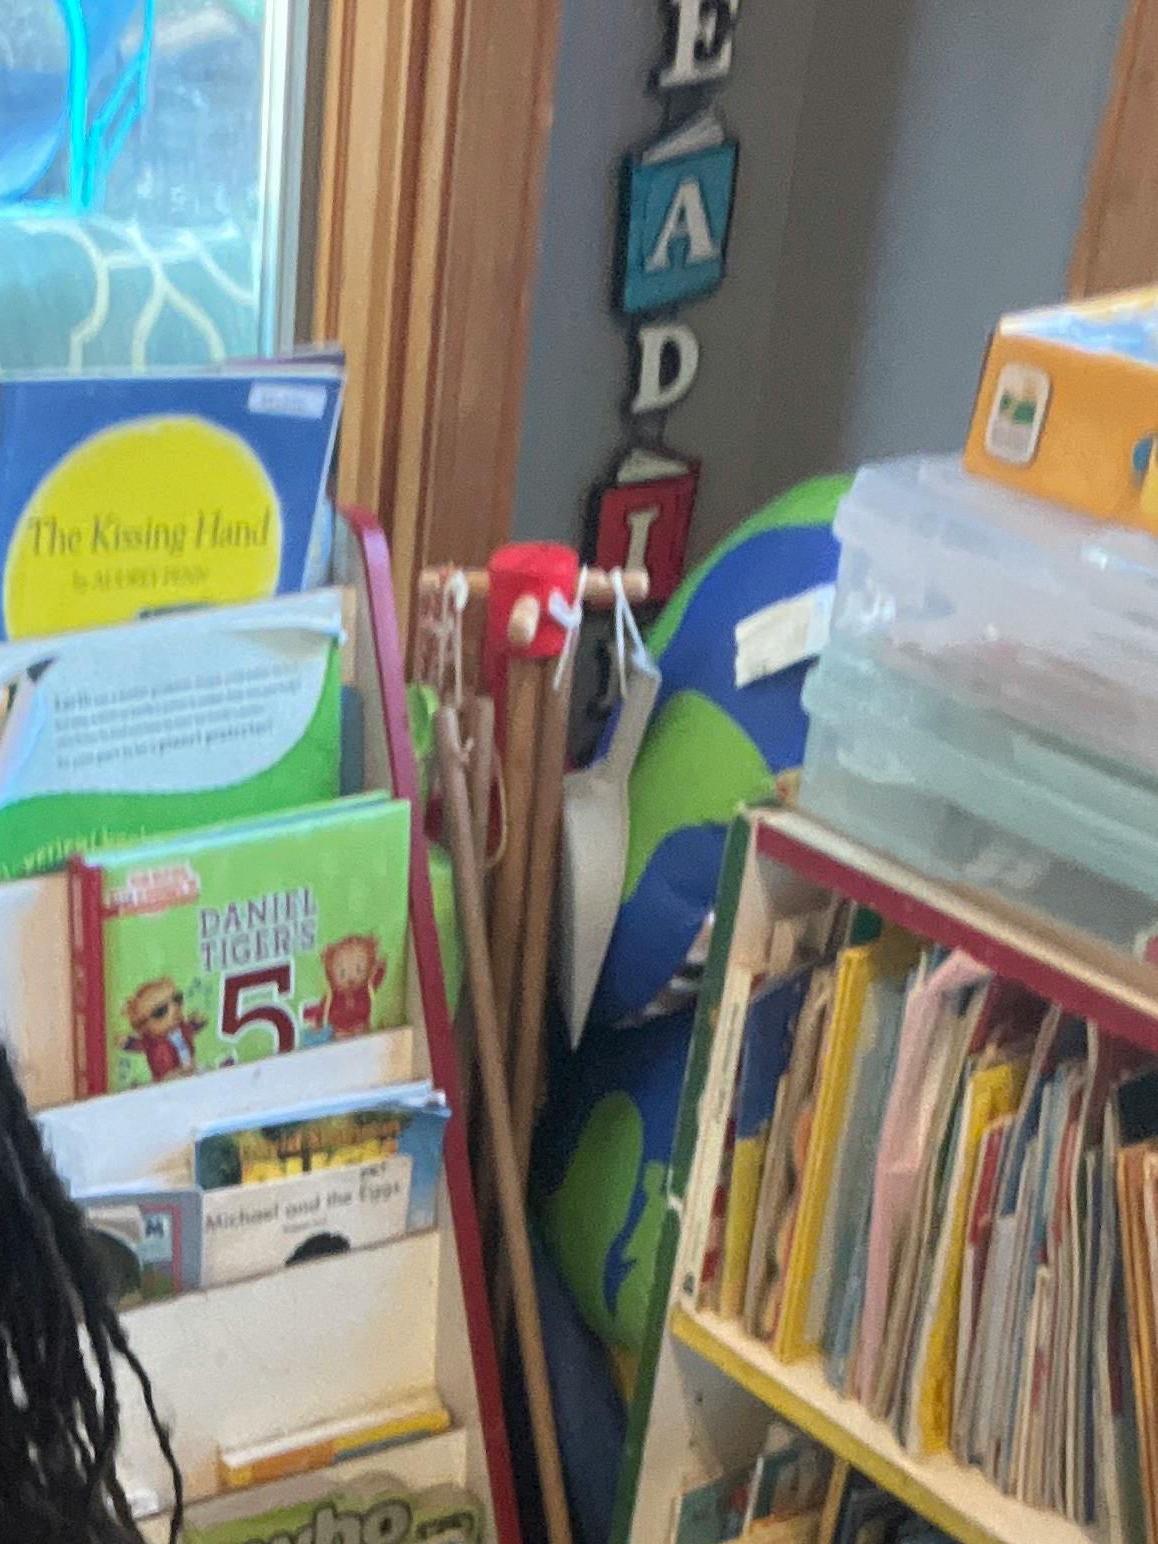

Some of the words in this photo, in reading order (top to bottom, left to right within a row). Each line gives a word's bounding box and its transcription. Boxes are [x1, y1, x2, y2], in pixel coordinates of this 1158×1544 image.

[28, 512, 82, 556] The
[92, 512, 187, 557] Kissing
[196, 506, 271, 548] Hand
[201, 886, 317, 938] DANIEL
[201, 921, 316, 972] TIGER'S
[206, 1204, 278, 1232] Michael
[285, 1194, 321, 1219] and
[327, 1188, 352, 1207] the
